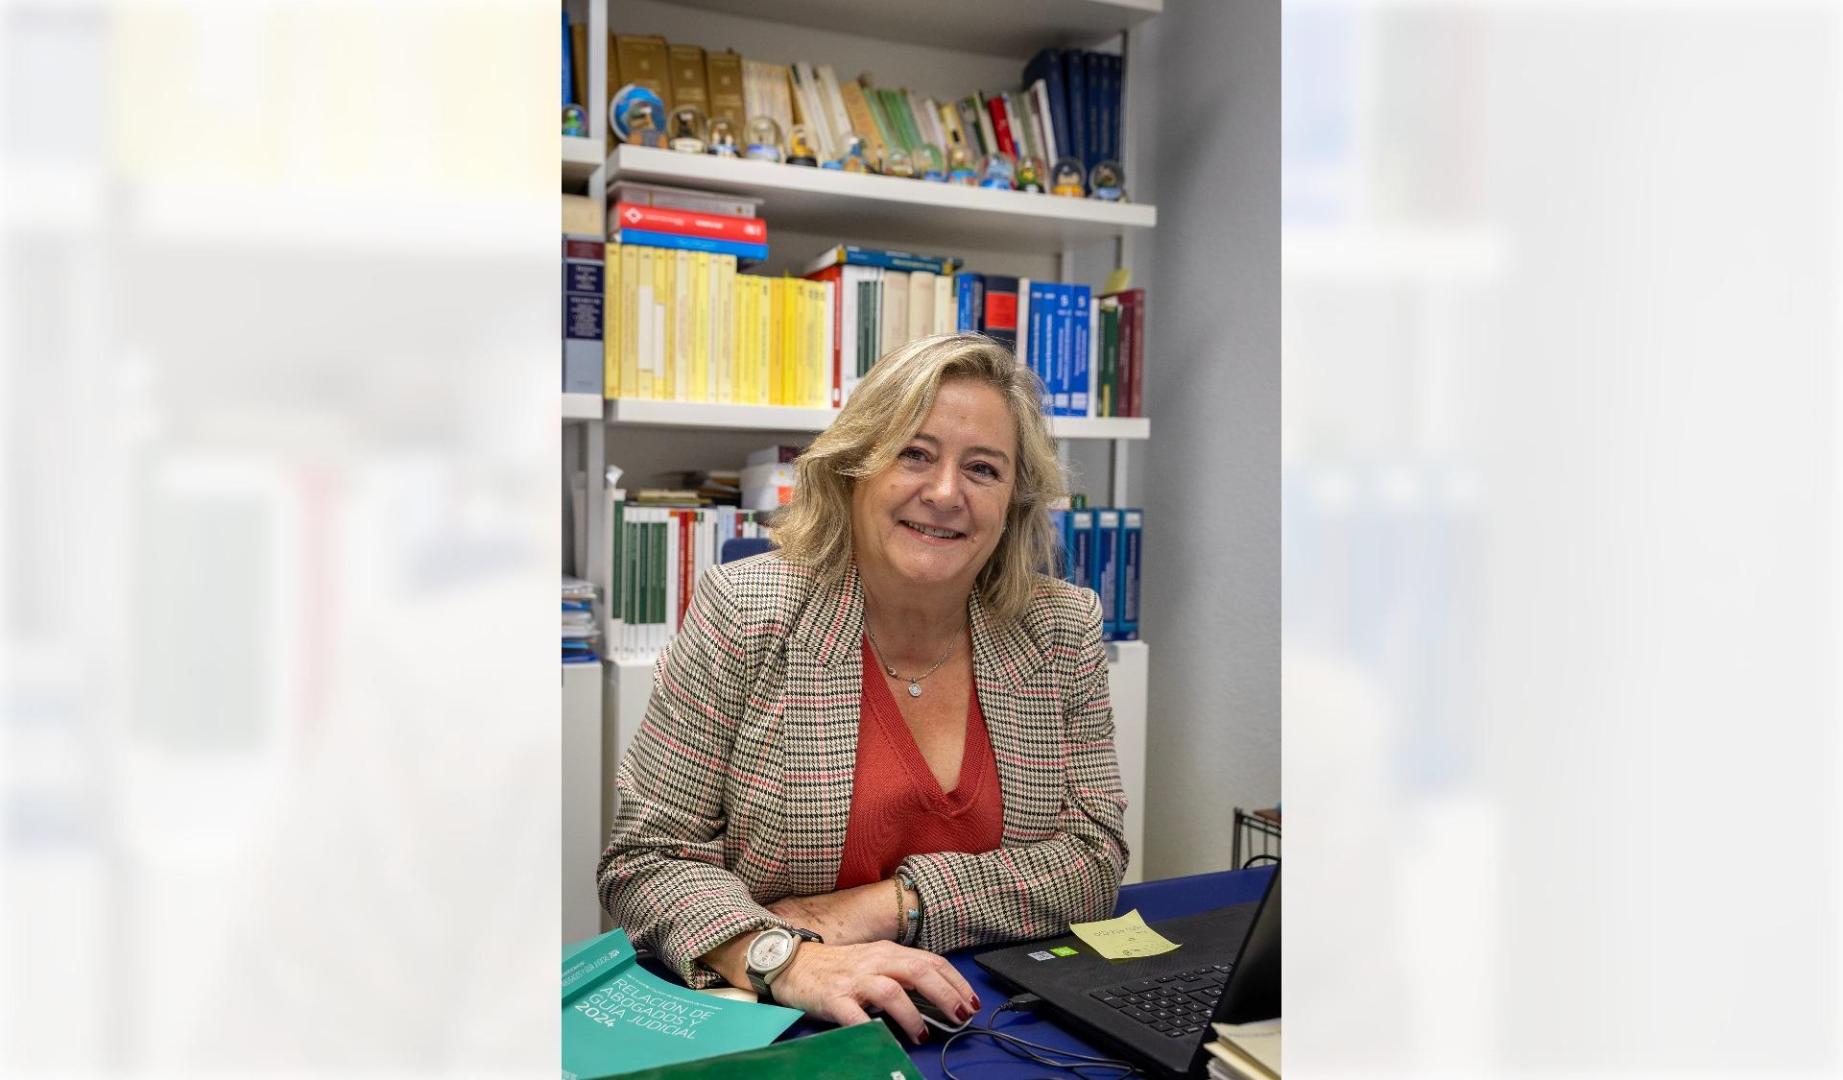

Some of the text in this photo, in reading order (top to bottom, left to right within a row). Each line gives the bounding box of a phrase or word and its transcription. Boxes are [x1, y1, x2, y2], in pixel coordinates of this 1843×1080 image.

[575, 1001, 616, 1027] 2024
[600, 987, 687, 1025] ABOGADOS
[689, 1018, 702, 1028] Y
[613, 978, 689, 1014] RELACIÓN
[689, 1009, 715, 1020] DE
[627, 1016, 697, 1039] JUDICIAL
